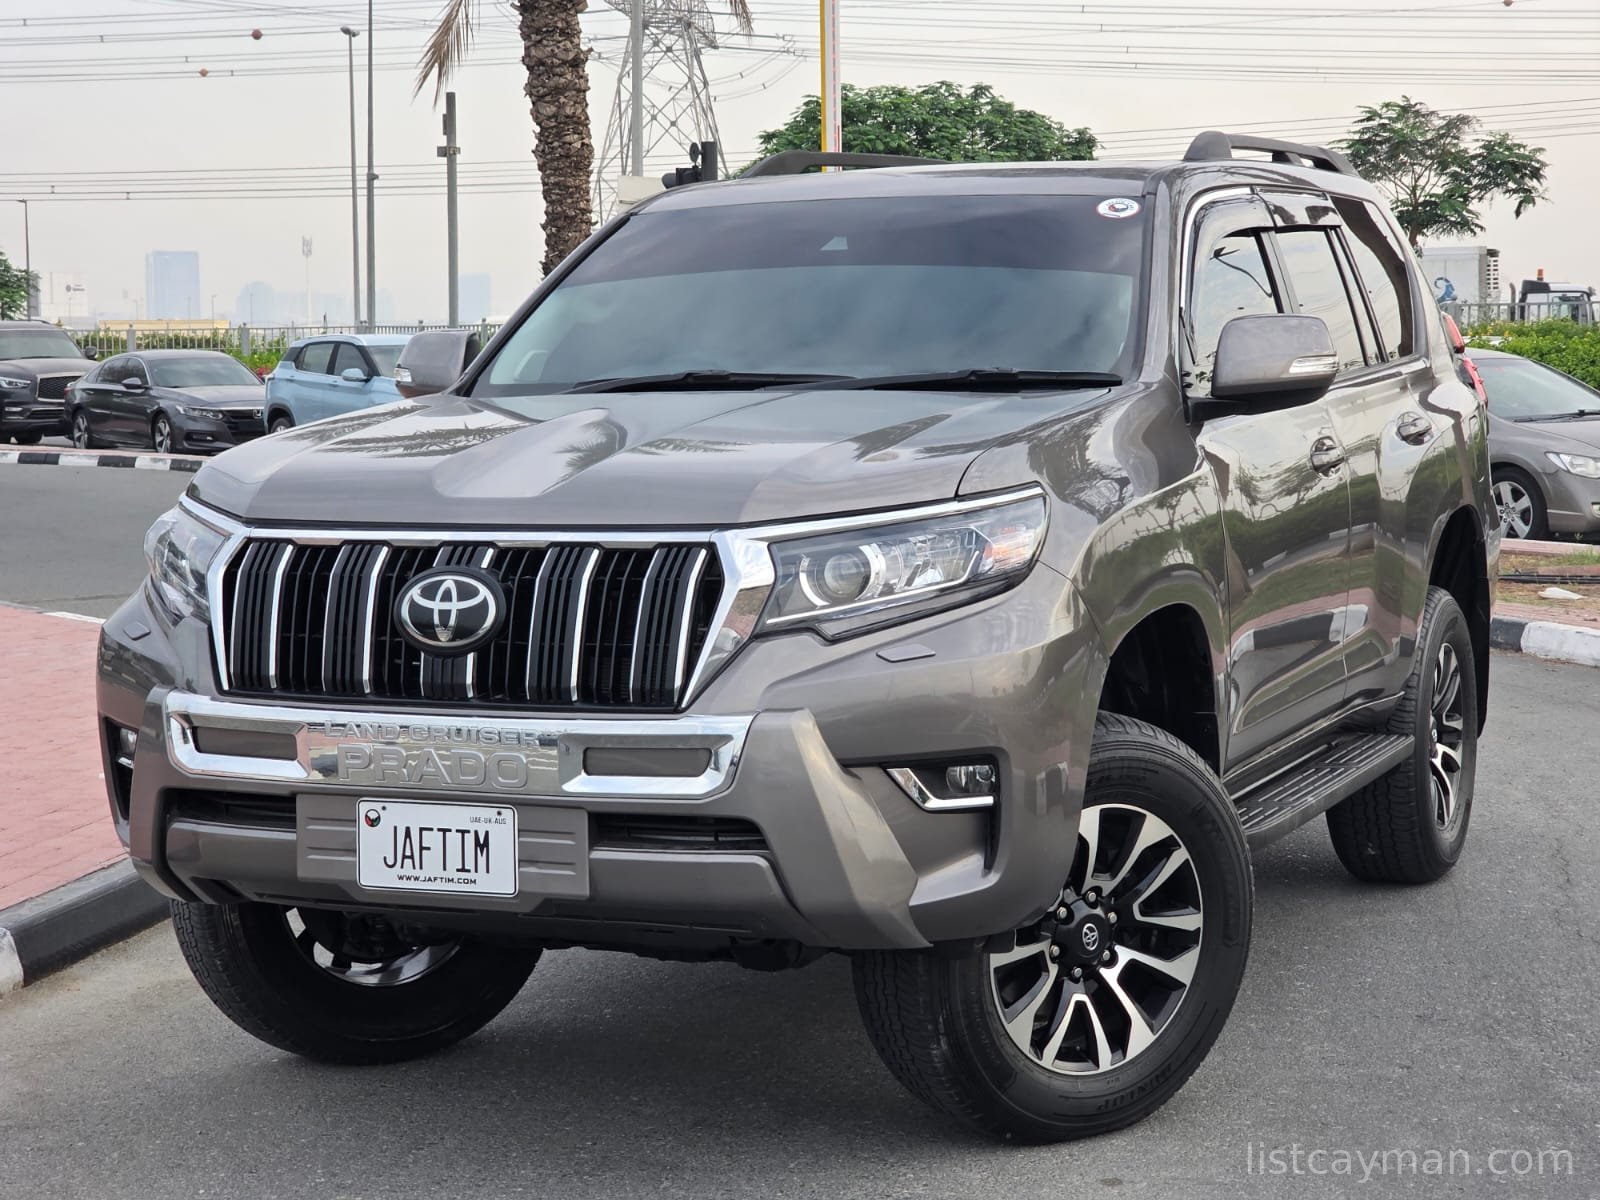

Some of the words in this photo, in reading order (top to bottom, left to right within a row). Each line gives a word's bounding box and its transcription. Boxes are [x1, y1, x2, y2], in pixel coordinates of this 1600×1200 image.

[324, 720, 401, 741] LAND
[409, 724, 540, 748] CRUISER
[337, 743, 528, 789] PRADO
[383, 825, 490, 874] JAFTIM
[397, 873, 477, 886] WWW.JAFTIM.COM
